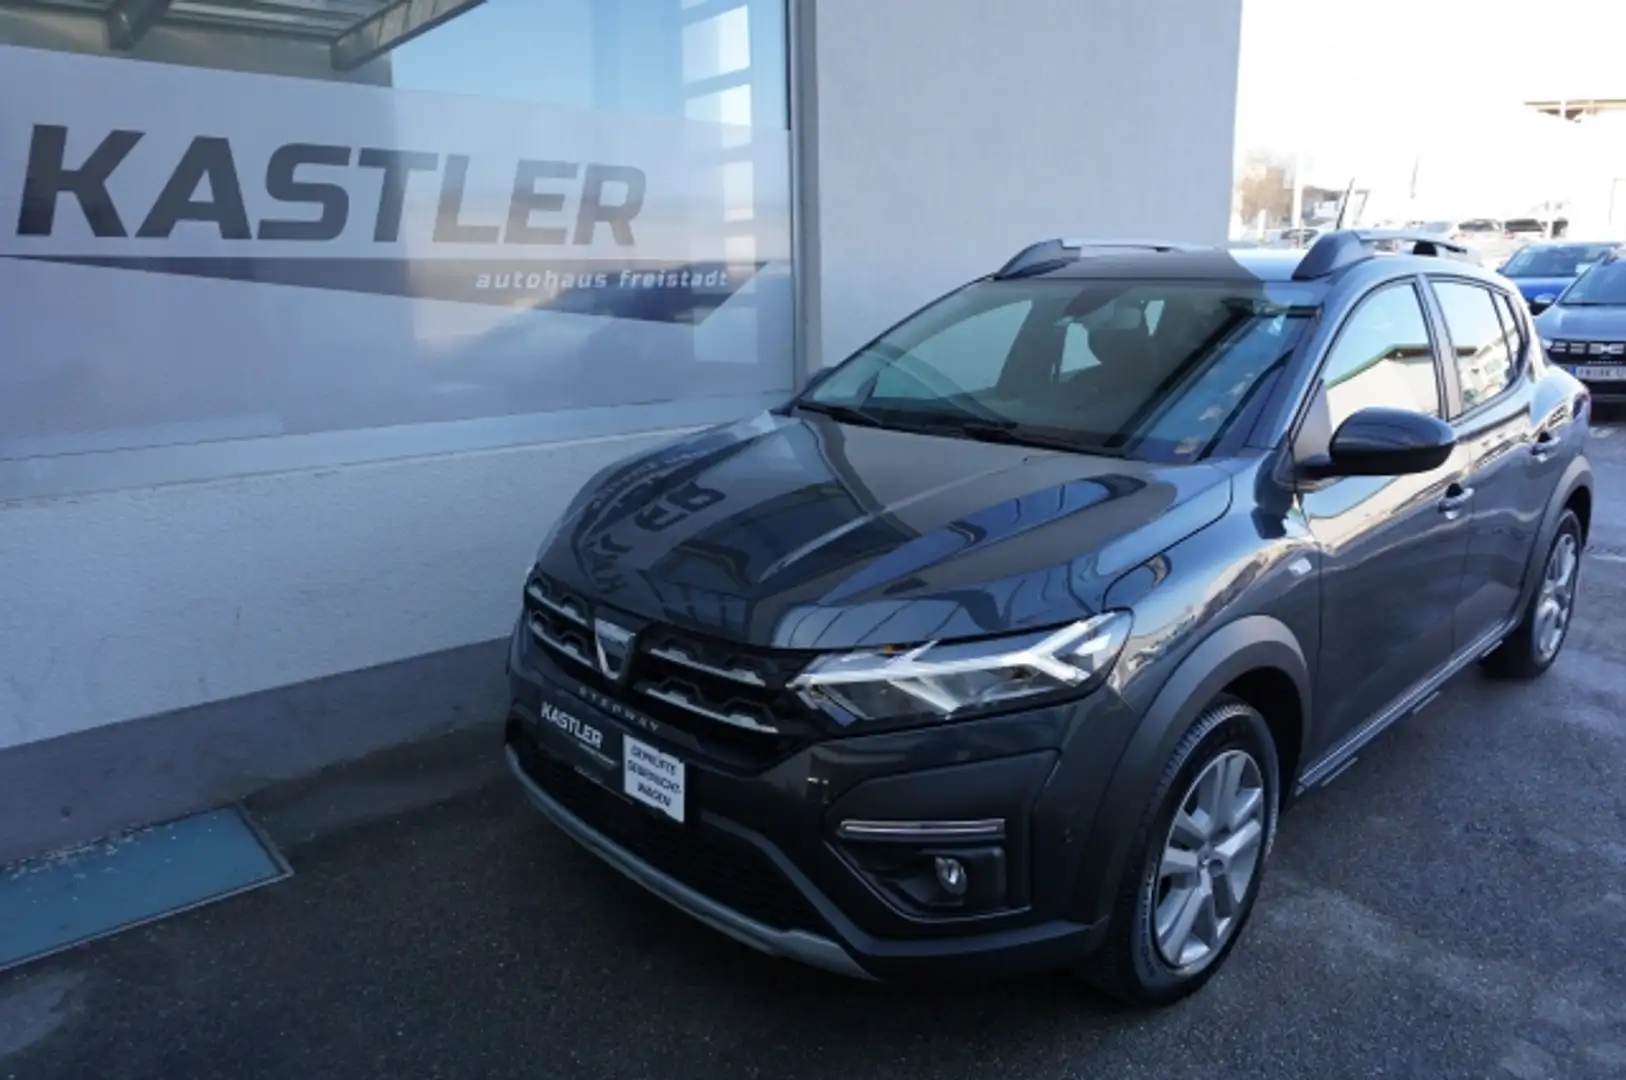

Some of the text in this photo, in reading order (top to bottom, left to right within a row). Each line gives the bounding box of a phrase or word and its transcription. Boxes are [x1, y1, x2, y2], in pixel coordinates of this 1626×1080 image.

[17, 123, 646, 247] KASTLER
[476, 268, 728, 290] autohaus freistadt
[541, 701, 604, 750] KASTLER
